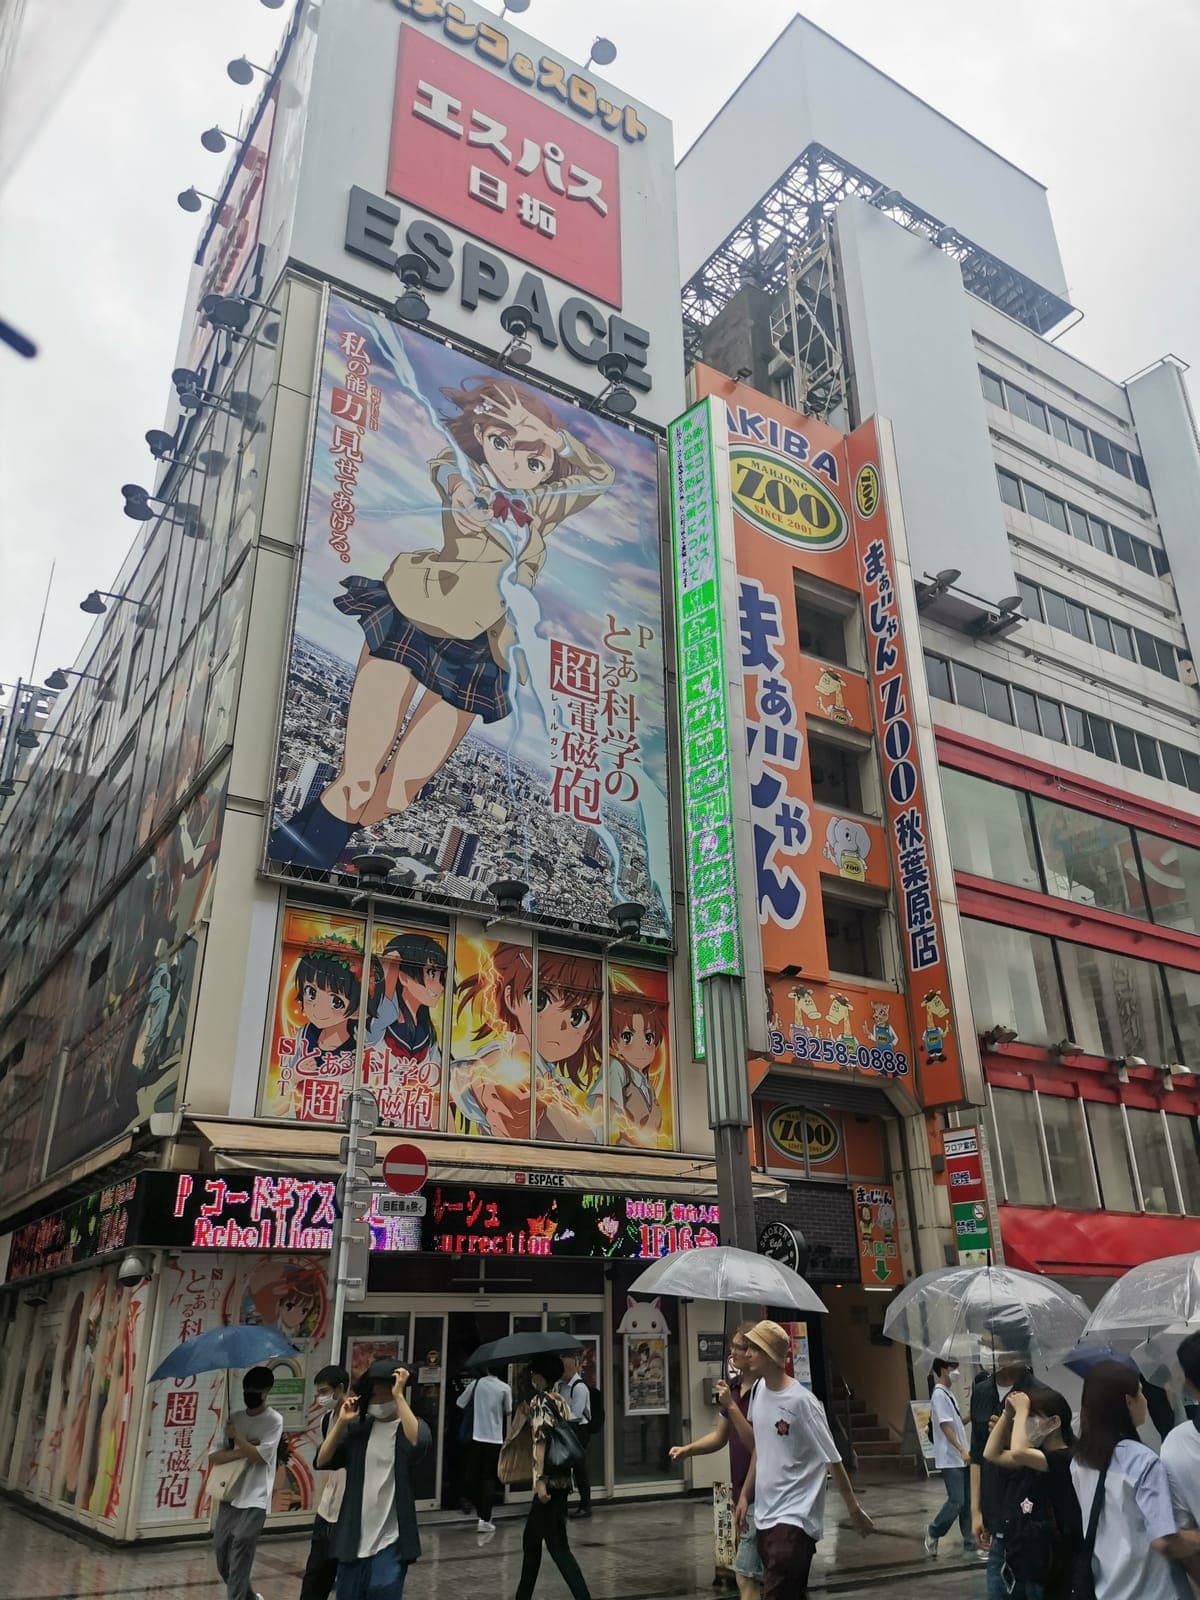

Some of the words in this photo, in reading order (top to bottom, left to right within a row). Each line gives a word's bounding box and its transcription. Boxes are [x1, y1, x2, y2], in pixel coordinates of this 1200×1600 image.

[412, 79, 608, 217] エスパス
[468, 164, 557, 238] 日拓
[345, 185, 652, 392] ESPACE
[736, 463, 831, 529] ZOO
[750, 460, 809, 492] MAHJONG
[754, 504, 783, 523] SINCE
[786, 518, 813, 536] 2001
[637, 624, 654, 649] P
[550, 638, 602, 826] 超電磁砲
[601, 614, 642, 803] とある科学の
[768, 1032, 908, 1074] 3-3258-0888
[528, 1174, 564, 1186] ESPACE
